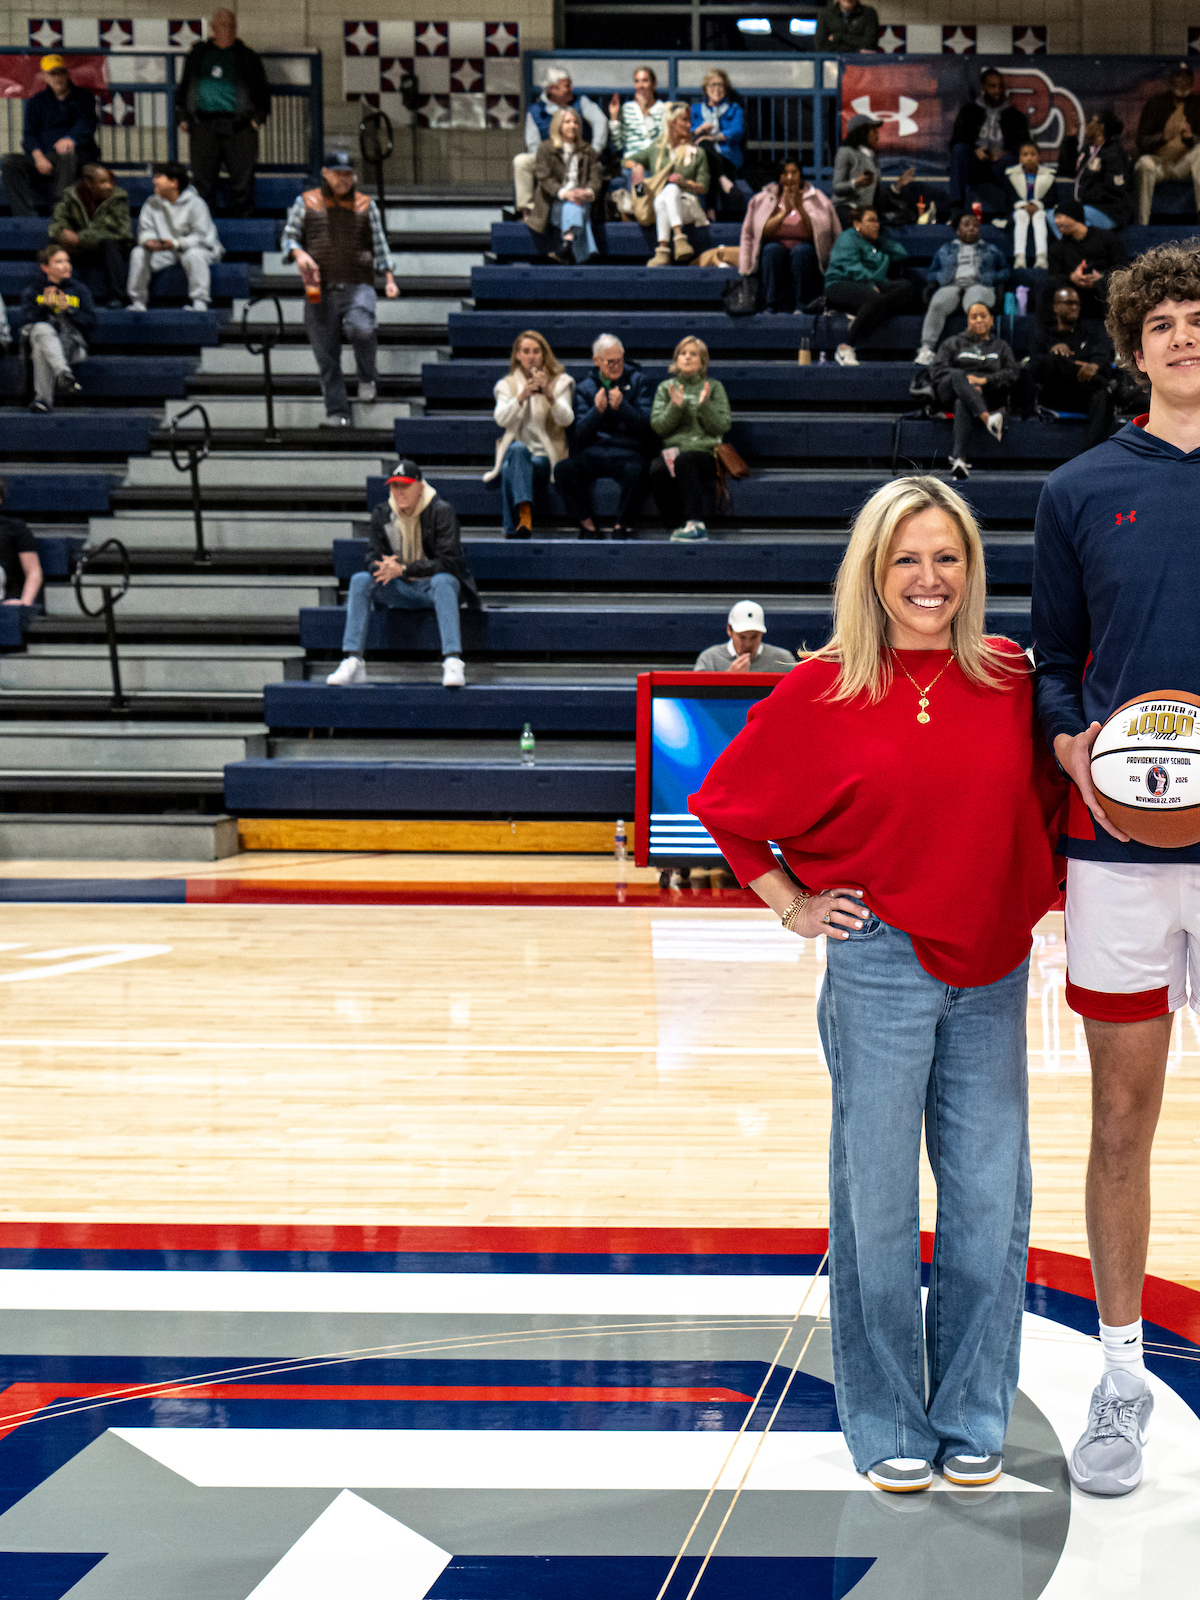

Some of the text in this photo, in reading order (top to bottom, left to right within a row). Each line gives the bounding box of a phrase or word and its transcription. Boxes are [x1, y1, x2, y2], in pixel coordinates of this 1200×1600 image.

[1151, 704, 1186, 714] BATTIER
[1188, 709, 1197, 718] #1
[1127, 712, 1194, 737] 1000
[1137, 726, 1177, 741] Points
[1126, 756, 1191, 765] PROVIDENCE DAY SCHOOL
[1136, 795, 1160, 804] NOVEMBER
[1169, 796, 1181, 804] 2025
